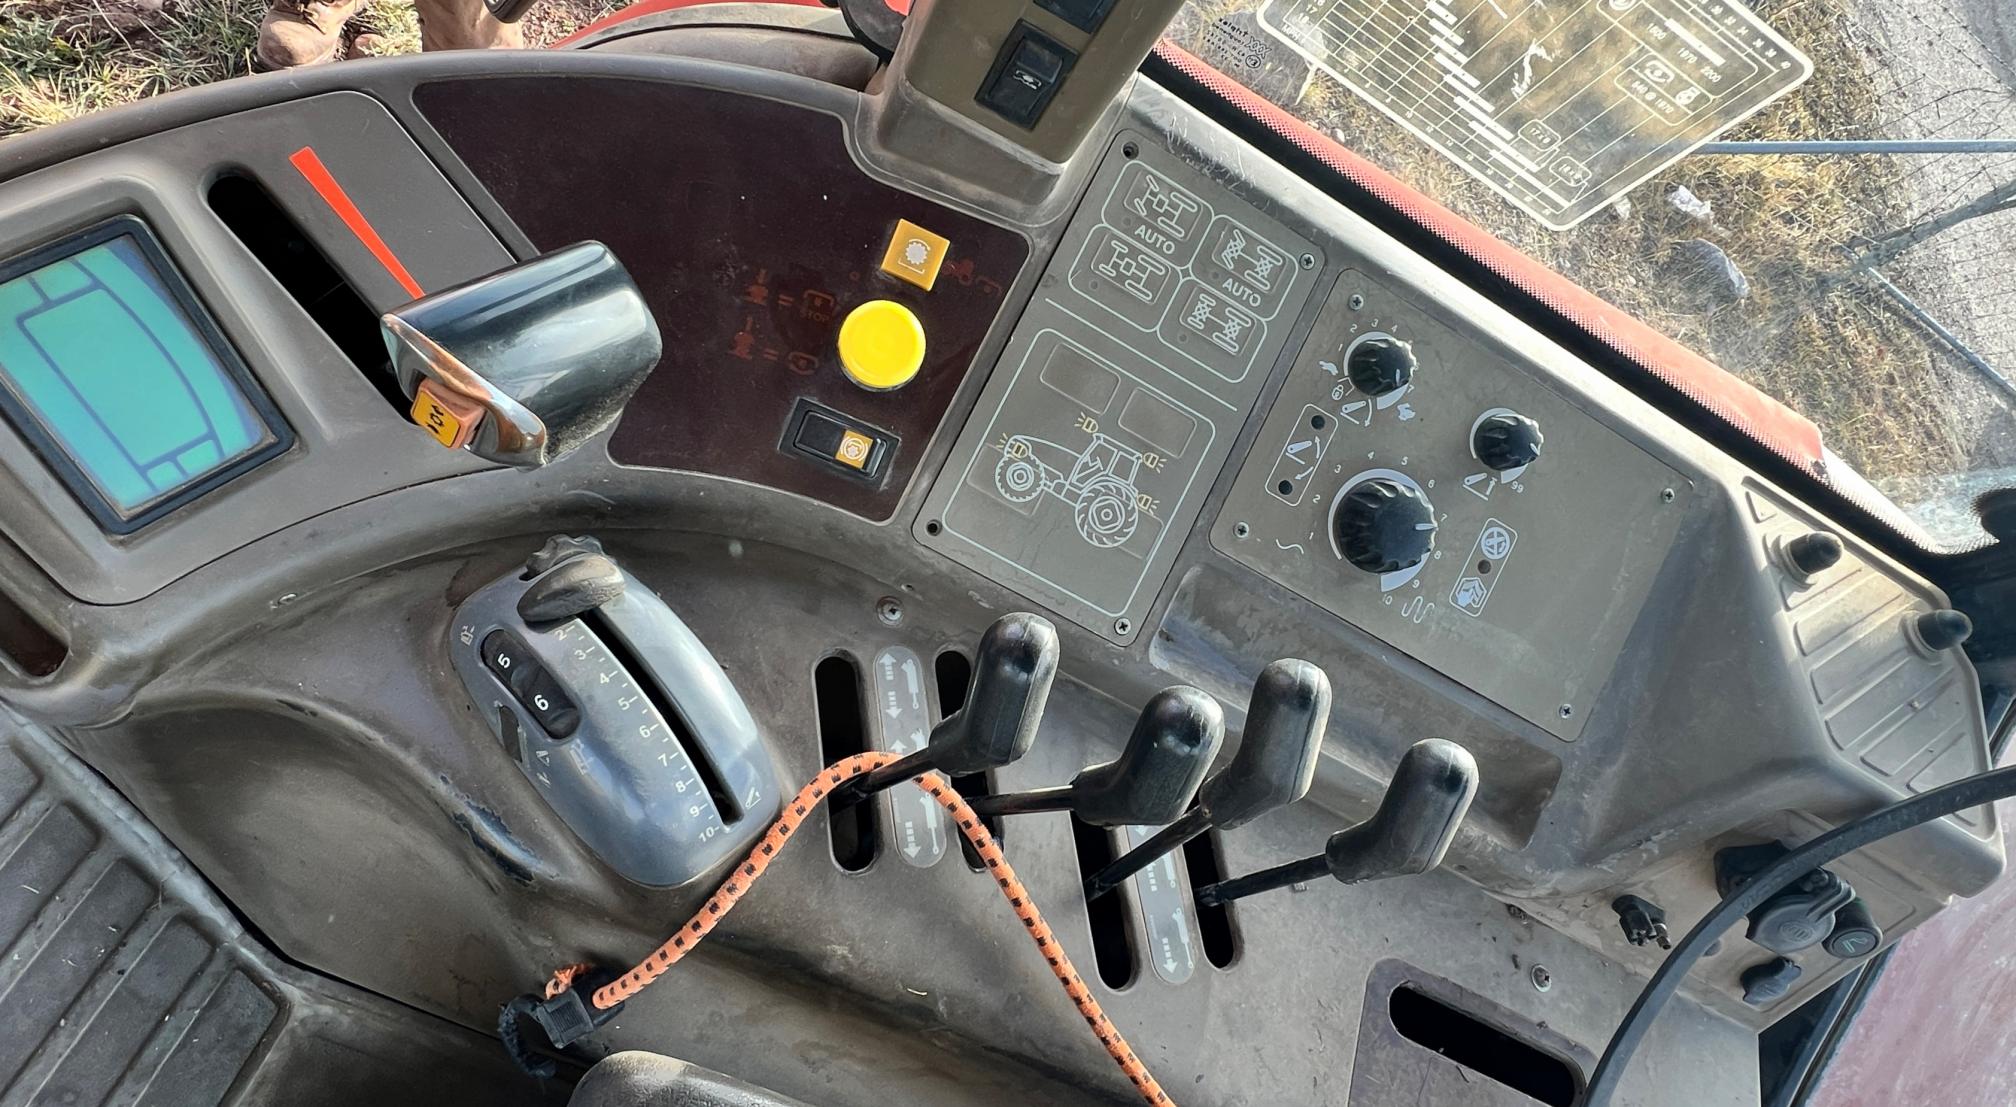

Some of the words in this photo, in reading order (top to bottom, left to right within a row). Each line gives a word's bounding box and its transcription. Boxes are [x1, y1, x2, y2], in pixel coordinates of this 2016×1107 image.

[1700, 65, 1722, 83] 2200
[1134, 224, 1175, 255] AUTO
[1222, 278, 1261, 307] AUTO
[1350, 324, 1357, 333] 2
[1371, 319, 1378, 328] 3
[1391, 324, 1398, 332] 4
[1338, 343, 1343, 351] 1
[1367, 451, 1374, 460] 4
[1401, 456, 1408, 465] 5
[1334, 464, 1342, 474] 3
[1428, 479, 1435, 488] 6
[1511, 480, 1524, 493] 99
[1313, 494, 1321, 503] 2
[1441, 514, 1448, 522] 7
[1434, 550, 1441, 559] 8
[1412, 579, 1420, 588] 9
[1382, 594, 1394, 605] 10
[554, 629, 567, 640] 2
[574, 649, 586, 659] 3
[497, 653, 511, 668] 5
[600, 672, 610, 684] 4
[534, 694, 549, 711] 6
[618, 697, 630, 710] 5
[639, 725, 651, 738] 6
[657, 753, 668, 767] 7
[675, 780, 686, 793] 8
[689, 805, 700, 817] 9
[699, 826, 715, 842] 10
